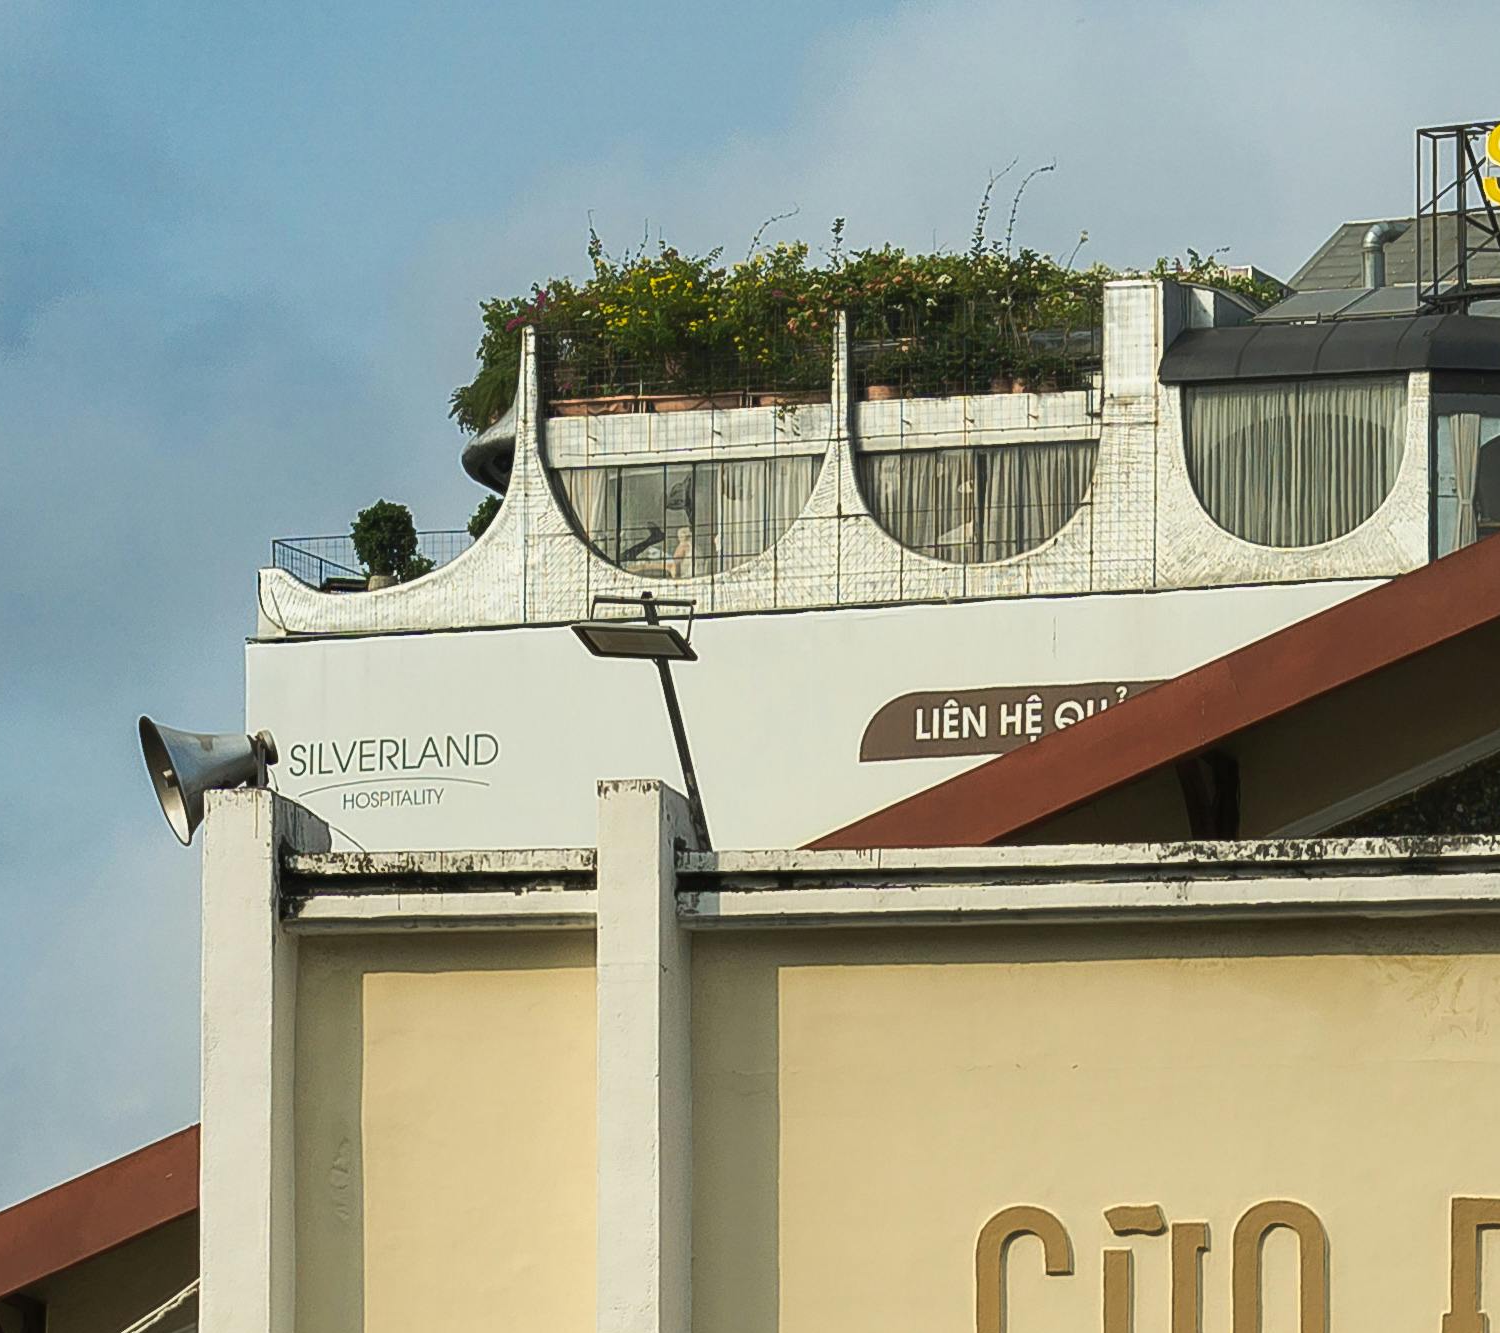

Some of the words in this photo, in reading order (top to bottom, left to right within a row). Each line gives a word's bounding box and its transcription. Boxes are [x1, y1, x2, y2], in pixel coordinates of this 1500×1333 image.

[915, 698, 987, 740] LIÊN
[1000, 694, 1044, 742] HỆ
[289, 733, 499, 776] SILVERLAND
[342, 787, 445, 810] HOSPITALITY
